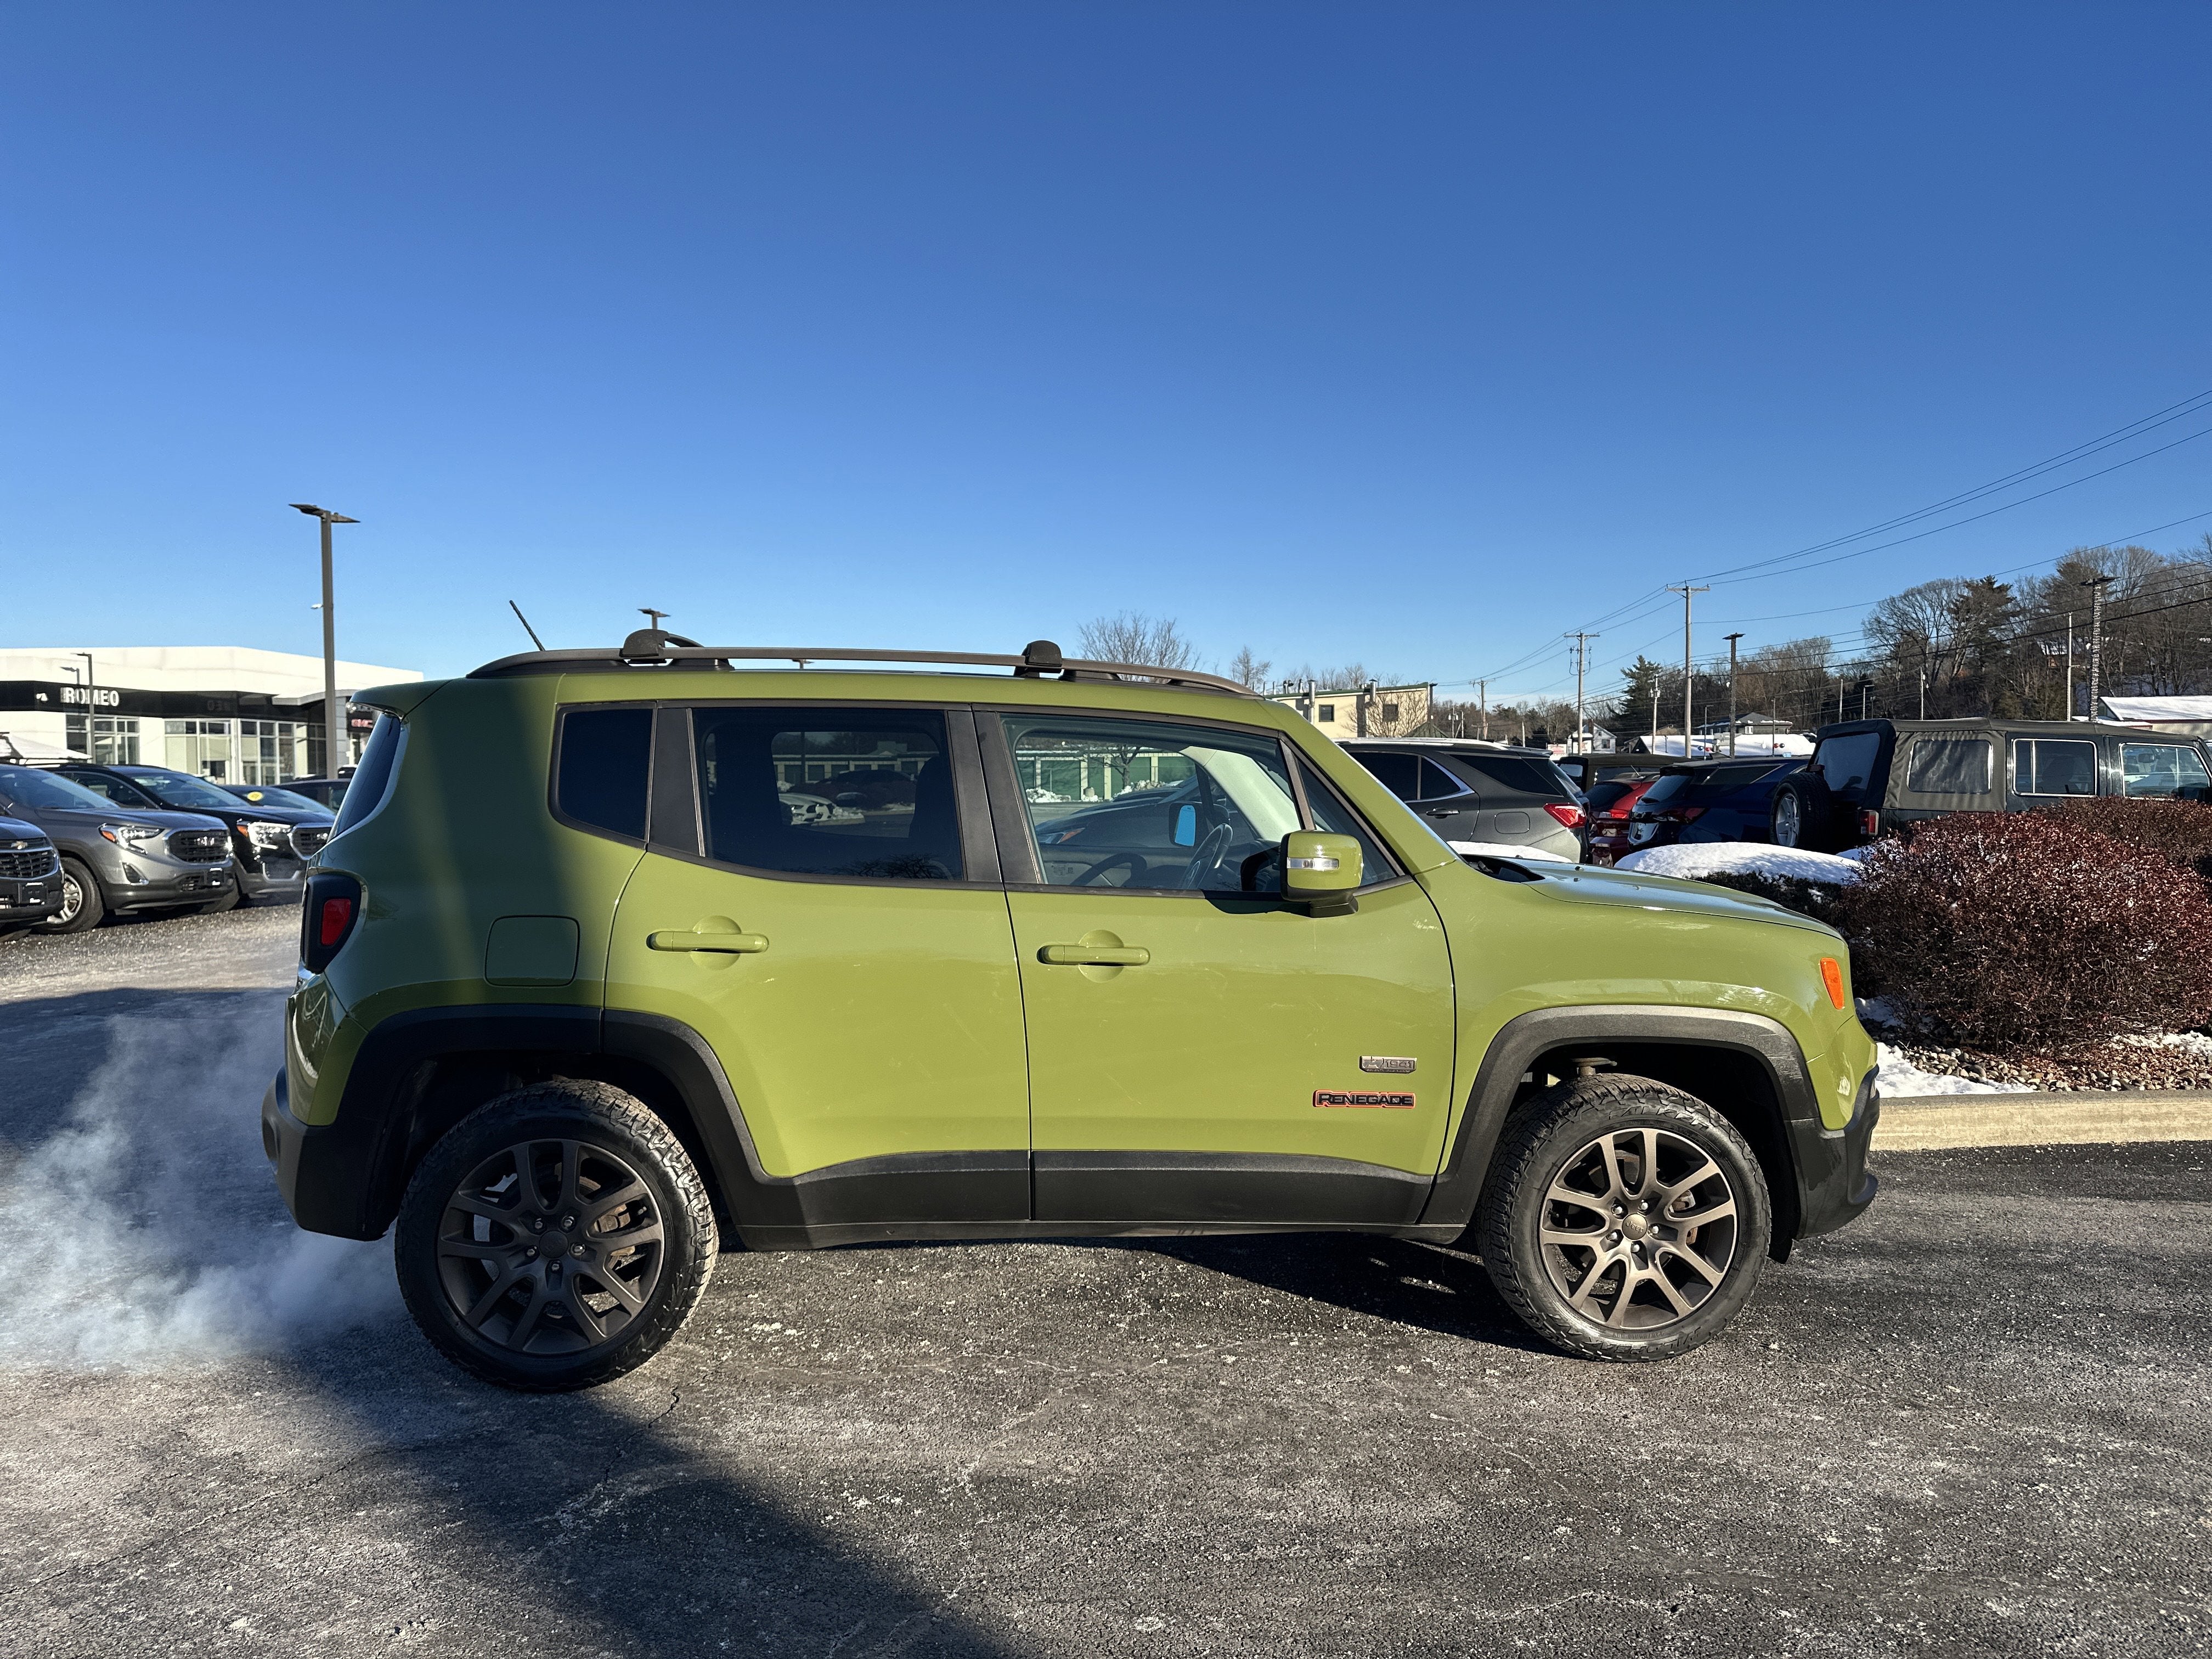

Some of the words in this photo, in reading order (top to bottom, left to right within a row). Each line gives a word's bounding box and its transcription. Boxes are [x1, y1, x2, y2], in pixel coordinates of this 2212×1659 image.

[60, 687, 119, 707] ROMEO
[1385, 1059, 1412, 1069] 1941
[1317, 1092, 1414, 1106] RENEGADE
[1625, 1220, 1644, 1234] Jeep
